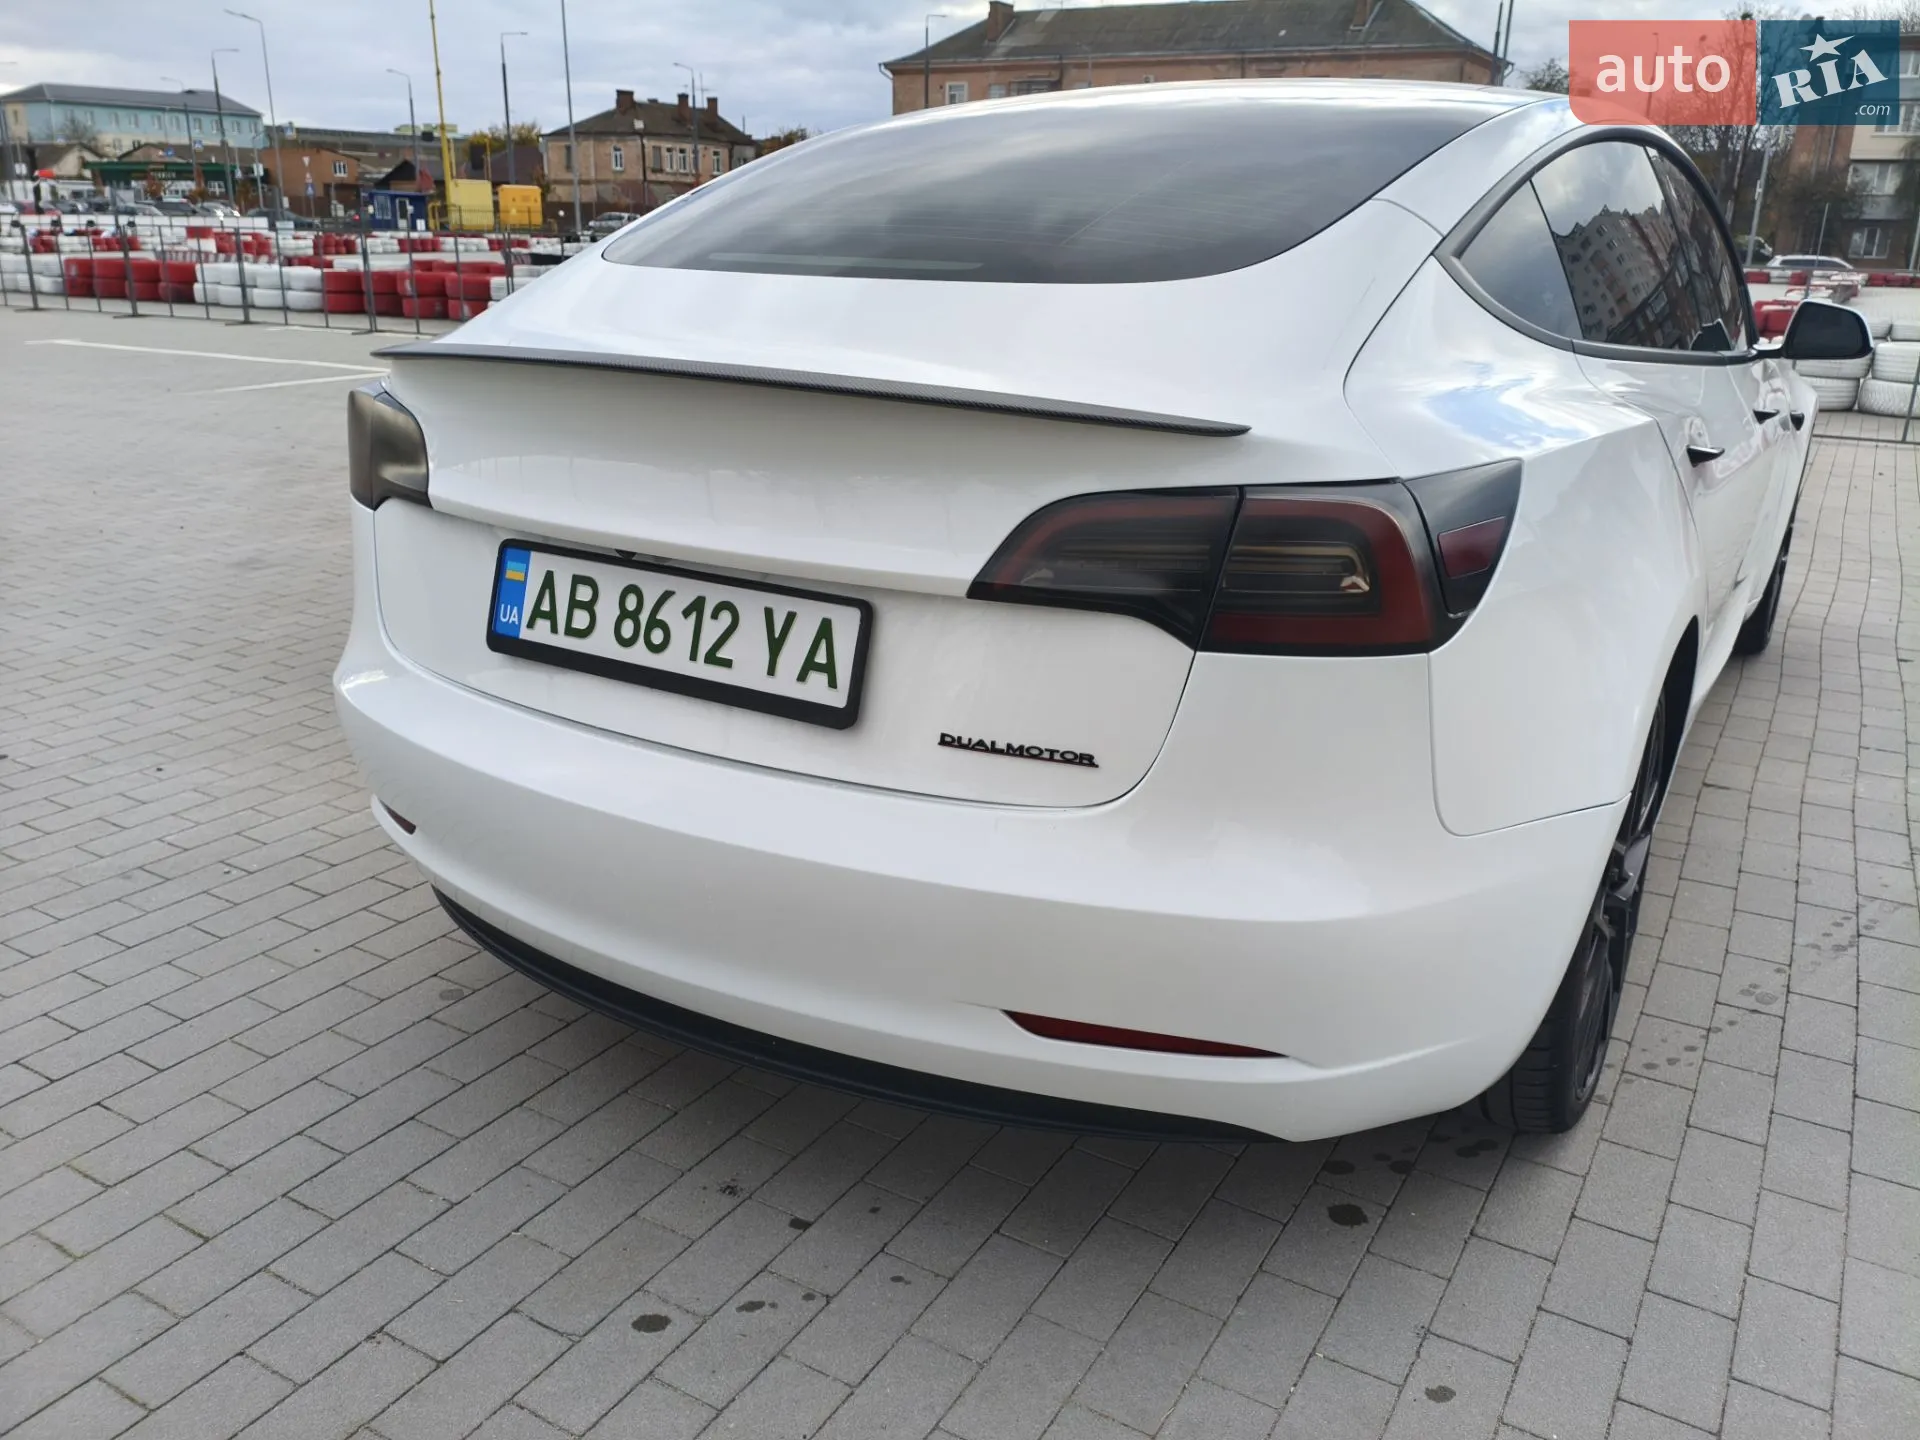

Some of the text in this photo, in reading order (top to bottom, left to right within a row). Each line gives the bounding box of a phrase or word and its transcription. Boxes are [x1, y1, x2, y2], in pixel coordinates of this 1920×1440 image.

[500, 603, 519, 625] UA
[526, 569, 838, 690] AB 8612 YA
